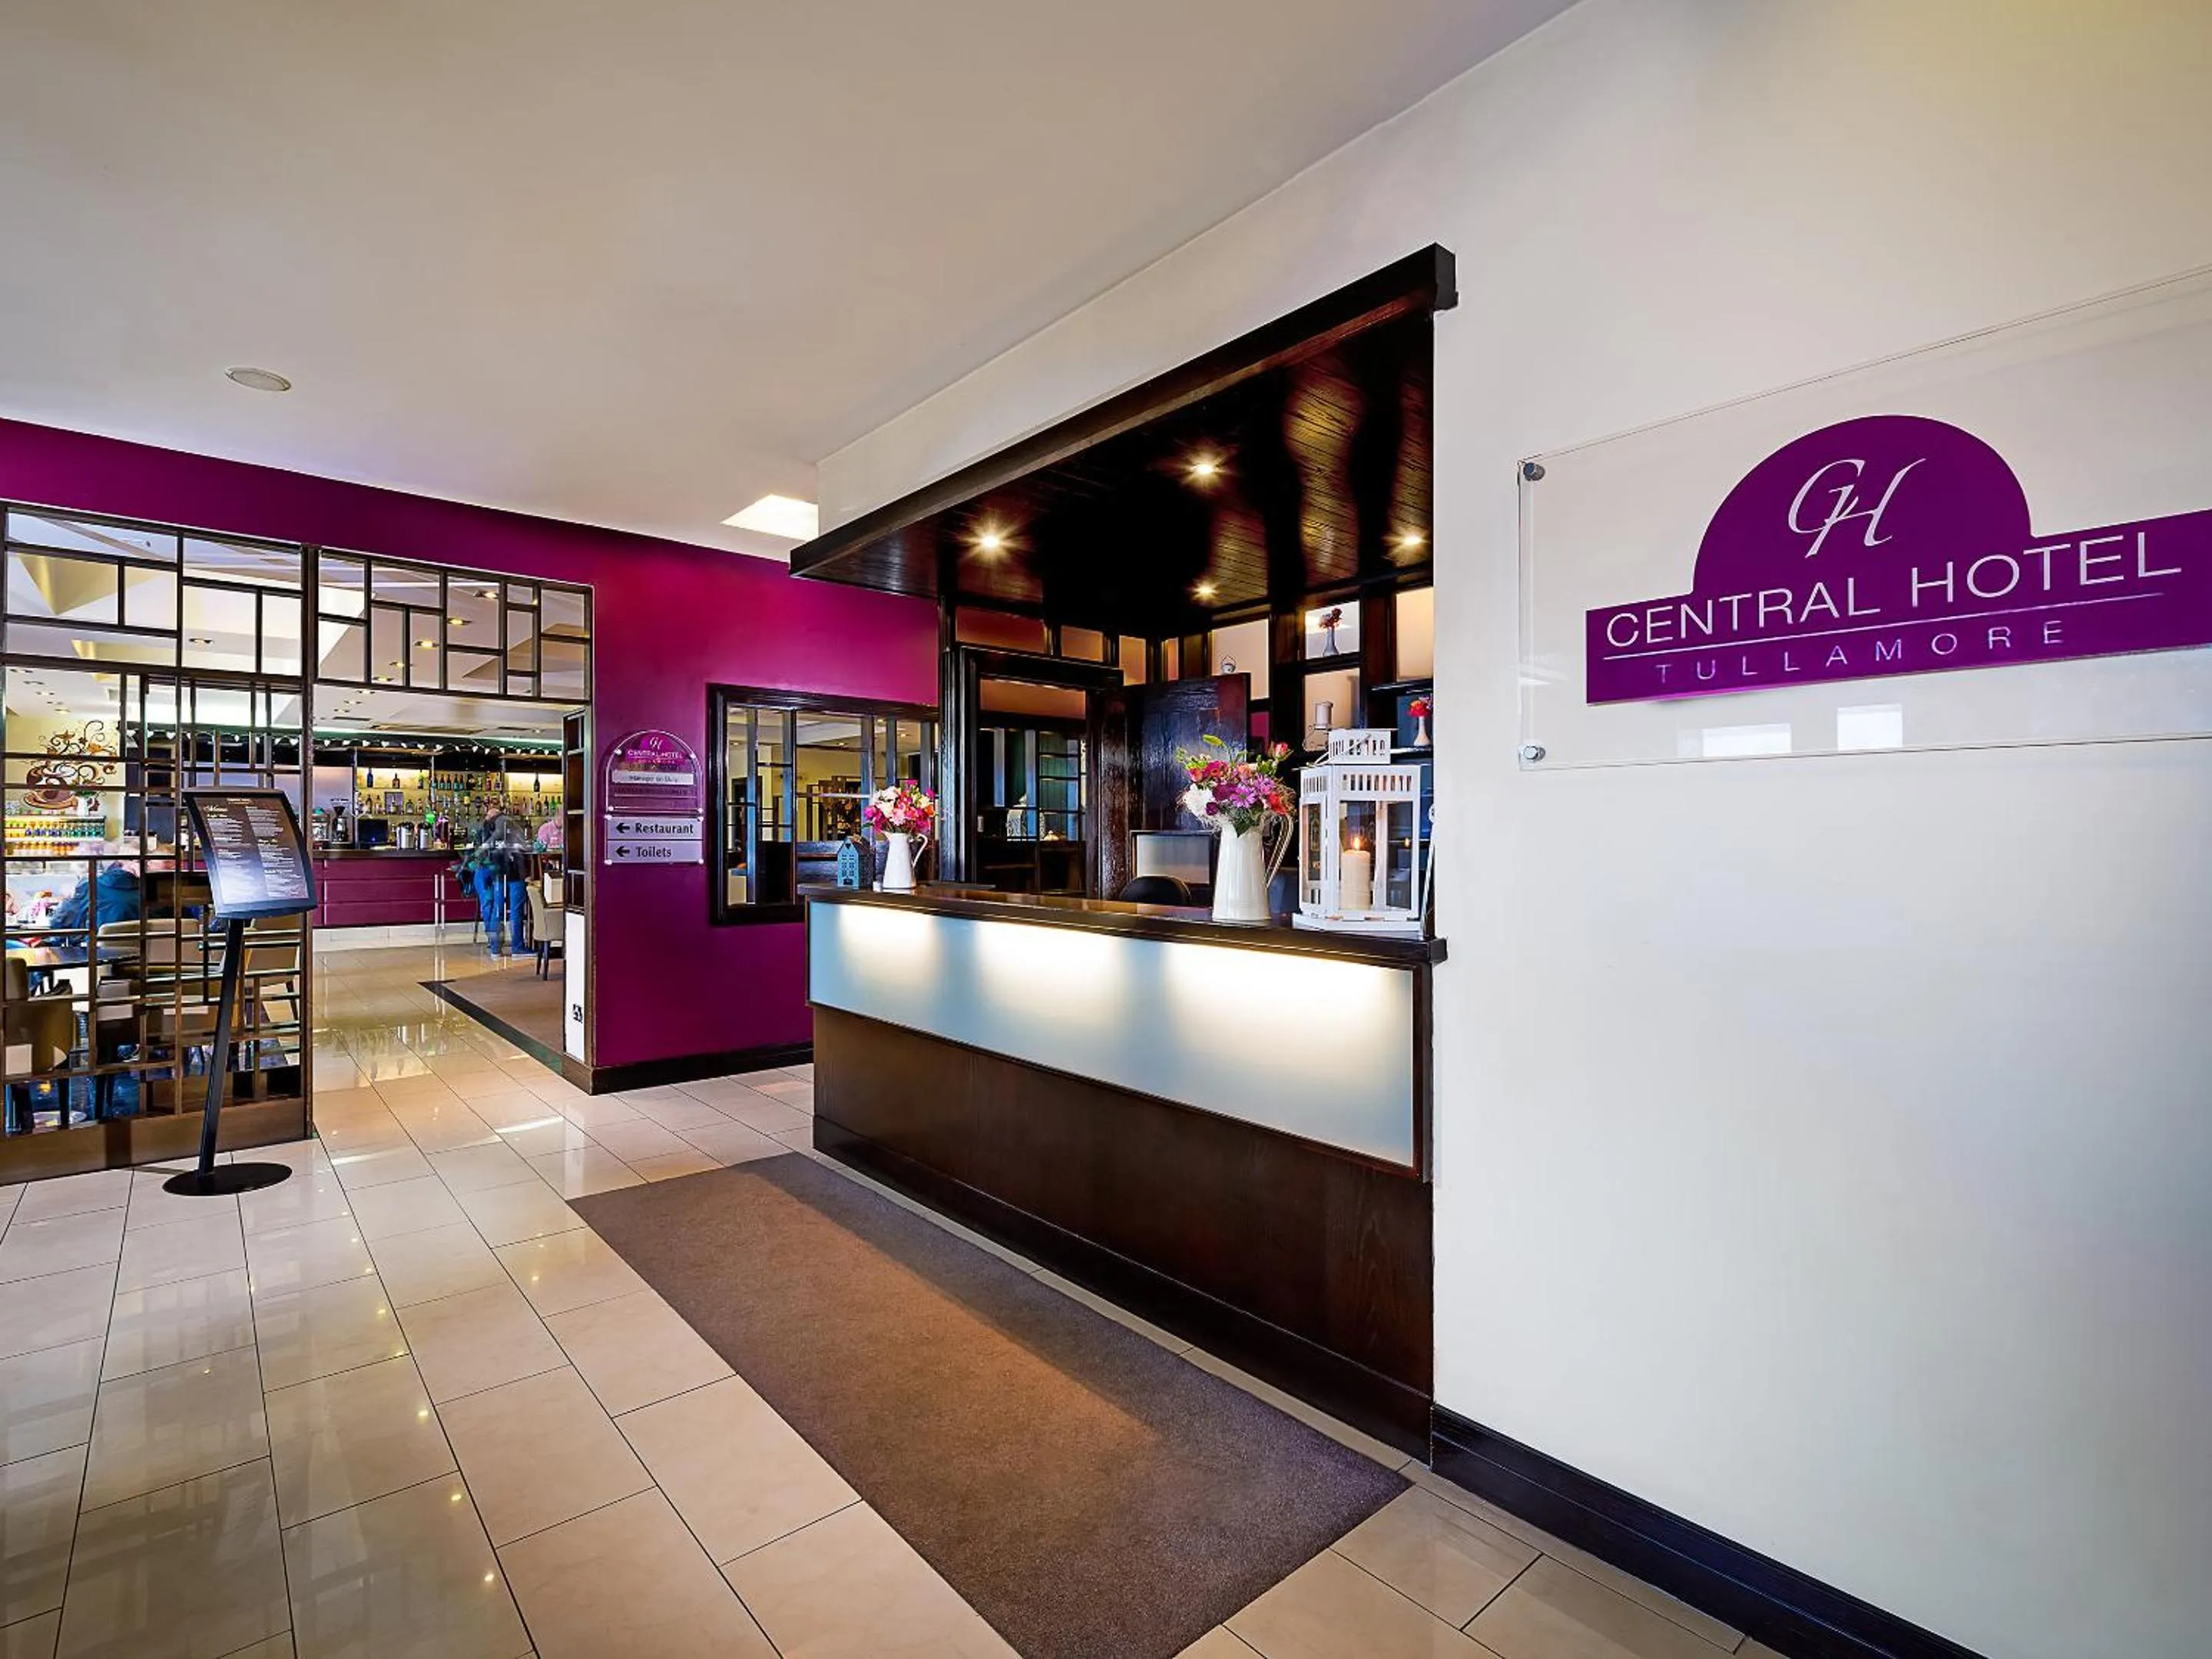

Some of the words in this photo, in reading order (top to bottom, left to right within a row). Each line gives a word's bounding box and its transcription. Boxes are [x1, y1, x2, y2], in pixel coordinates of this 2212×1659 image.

[1606, 577, 1882, 647] CENTRAL
[1911, 531, 2182, 608] HOTEL
[1654, 620, 2065, 684] TULLAMORE
[635, 822, 694, 834] Restaurant
[636, 846, 672, 857] Toilets
